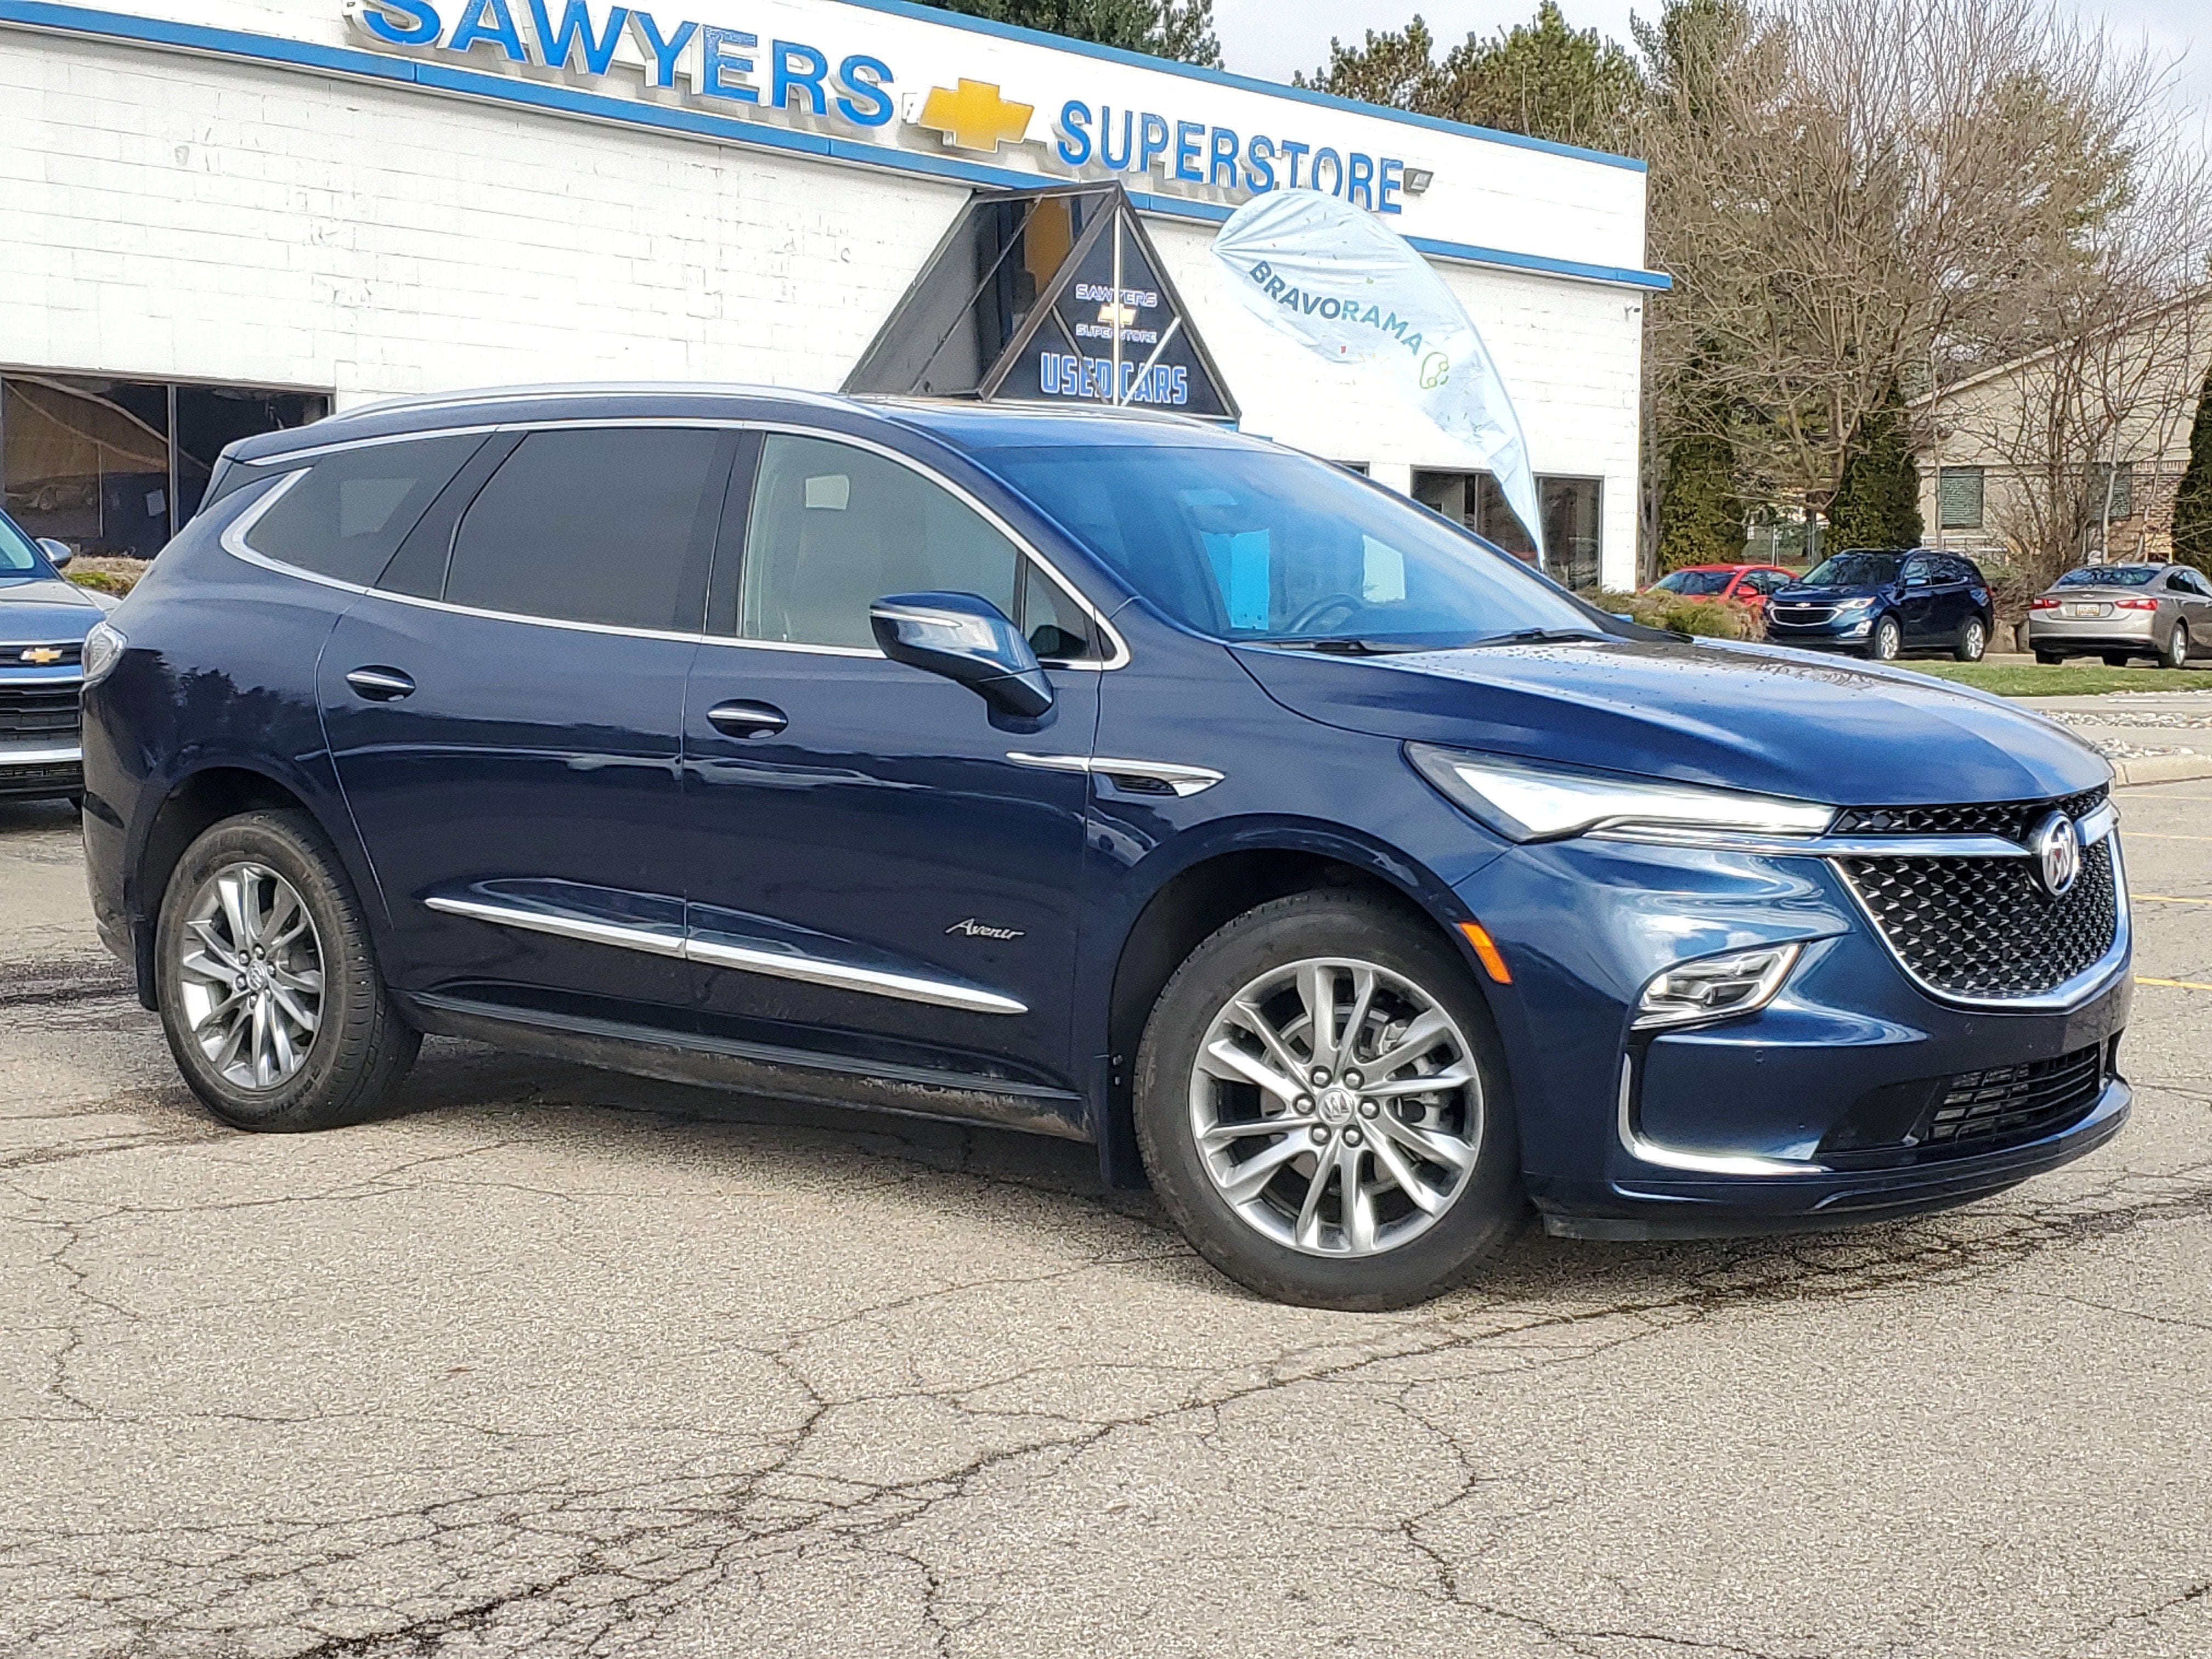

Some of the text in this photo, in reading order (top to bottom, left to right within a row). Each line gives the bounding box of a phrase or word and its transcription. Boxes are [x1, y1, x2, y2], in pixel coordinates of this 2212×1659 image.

[361, 0, 894, 127] SAWYERS
[1058, 100, 1403, 214] SUPERSTORE
[1249, 260, 1423, 356] BRAVORAMA
[1041, 352, 1188, 405] USED CARS
[945, 917, 1025, 940] Avenir
